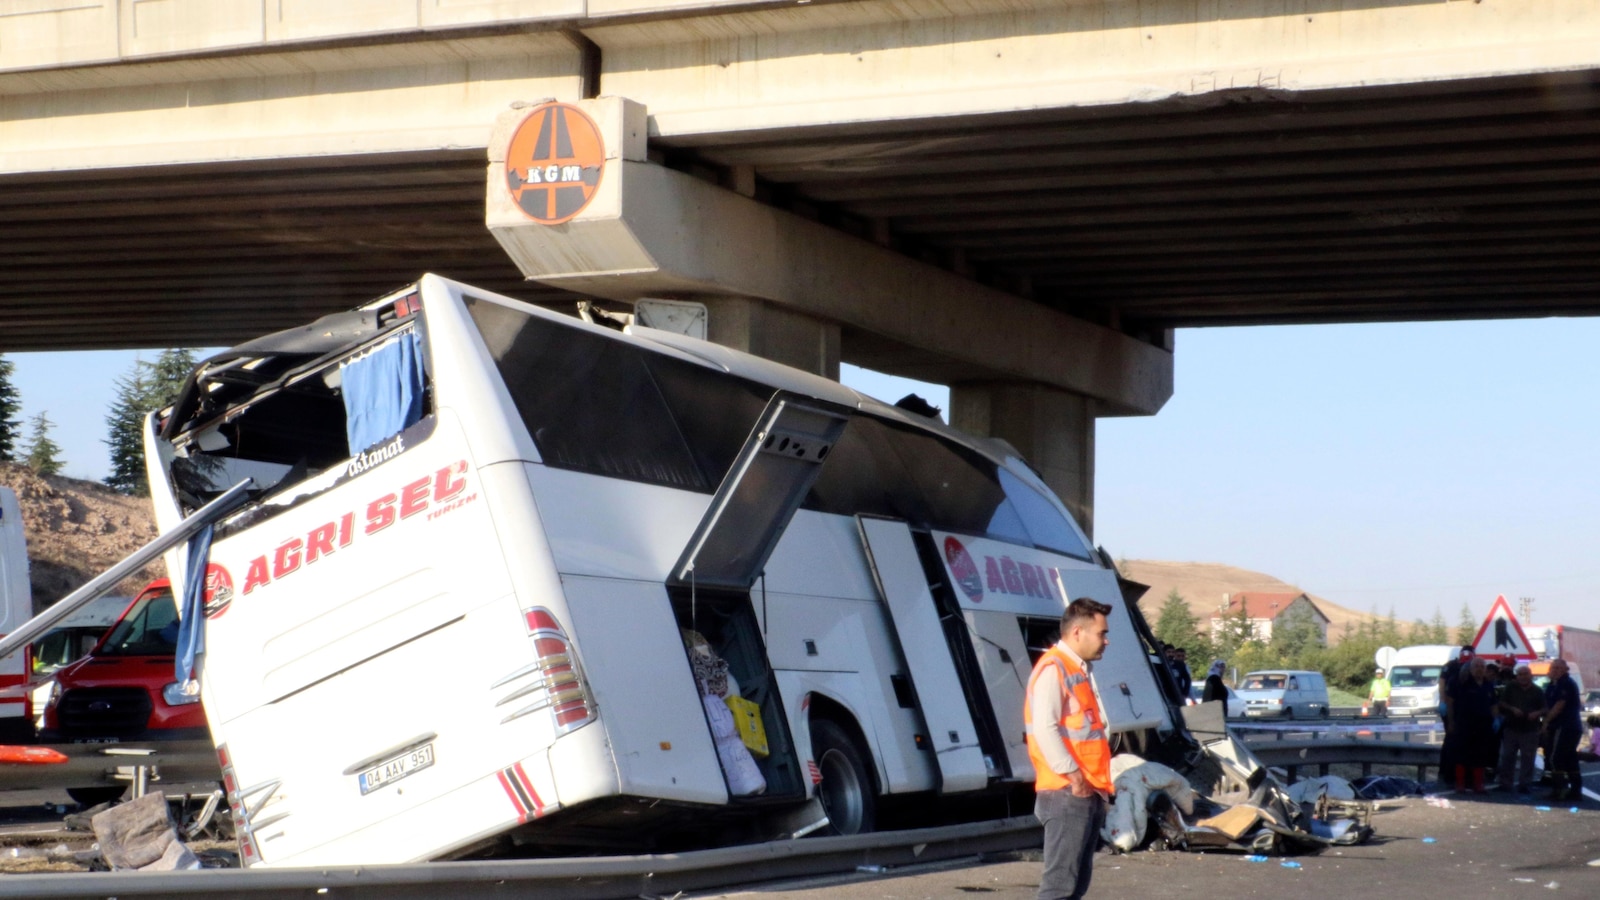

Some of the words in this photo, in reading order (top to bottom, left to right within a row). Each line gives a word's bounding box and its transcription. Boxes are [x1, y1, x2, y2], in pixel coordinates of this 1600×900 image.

[527, 165, 581, 183] KGM
[367, 770, 381, 787] 04
[386, 759, 405, 778] AAV
[411, 748, 431, 767] 951
